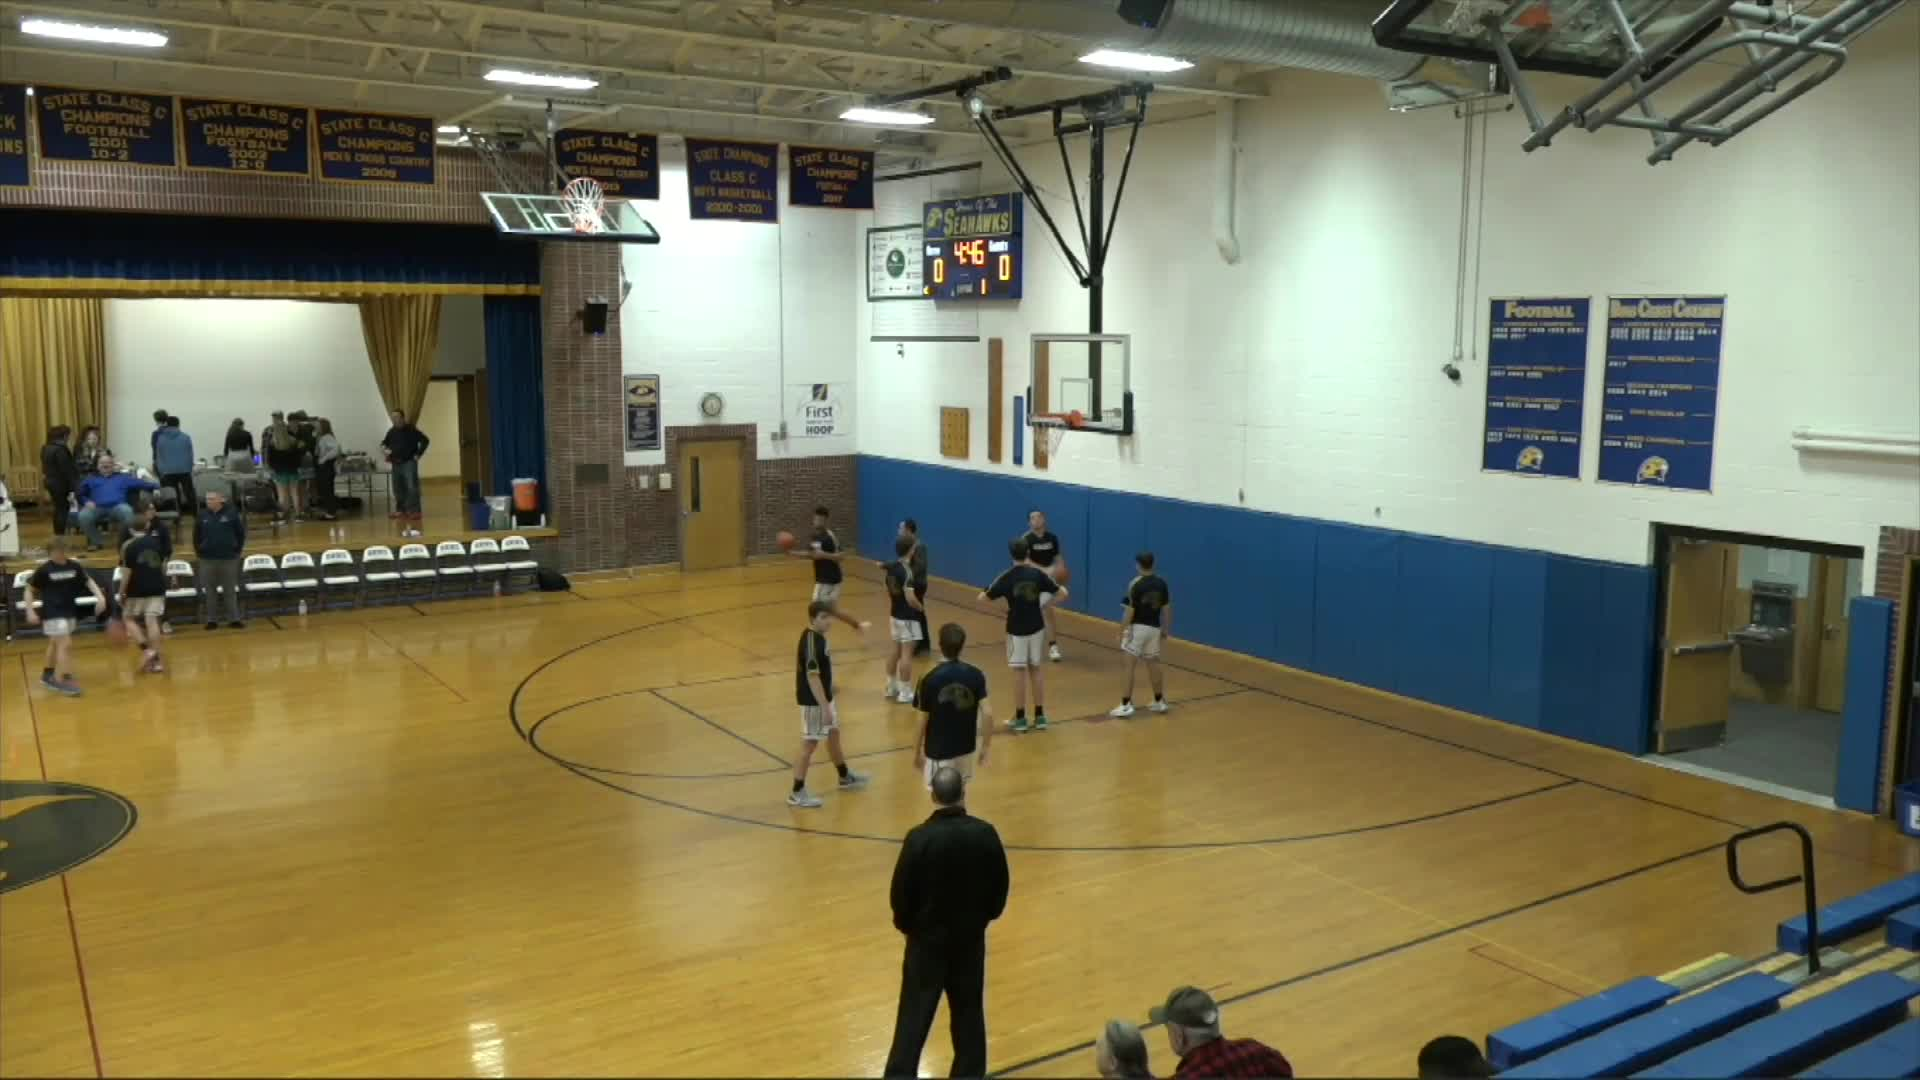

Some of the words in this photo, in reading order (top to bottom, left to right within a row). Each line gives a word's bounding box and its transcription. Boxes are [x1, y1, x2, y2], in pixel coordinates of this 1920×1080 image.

[42, 93, 92, 110] STATE
[96, 94, 150, 112] CLASS
[154, 106, 167, 120] C
[60, 109, 150, 126] CHAMPIONS
[186, 104, 232, 120] STATE
[237, 104, 288, 124] CLASS
[292, 117, 304, 129] C
[64, 123, 151, 138] FOOTBALL
[203, 123, 288, 140] CHAMPIONS
[320, 118, 364, 135] STATE
[368, 118, 416, 137] CLASS
[419, 131, 430, 143] C
[88, 136, 128, 148] 2001
[207, 136, 288, 152] FOOTBALL
[338, 136, 415, 153] CHAMPIONS
[562, 135, 595, 151] STATE
[602, 136, 639, 152] CLASS
[641, 146, 650, 158] C
[354, 152, 386, 165] CROSS
[389, 156, 430, 167] COUNTRY
[576, 151, 638, 167] CHAMPIONS
[694, 148, 720, 162] STATE
[794, 152, 824, 167] STATE
[829, 152, 859, 167] CLASS
[709, 169, 745, 184] CLASS
[749, 171, 757, 184] C
[807, 168, 859, 181] CHAMPIONS
[719, 187, 773, 201] BASKETBALL
[944, 207, 1009, 237] SEAHAWKS
[953, 239, 985, 265] 4:46
[934, 258, 944, 283] 0
[999, 255, 1010, 281] 0
[981, 278, 986, 295] 1
[1504, 300, 1575, 319] FOOTBALL
[806, 405, 832, 418] First
[806, 425, 834, 435] HOOP
